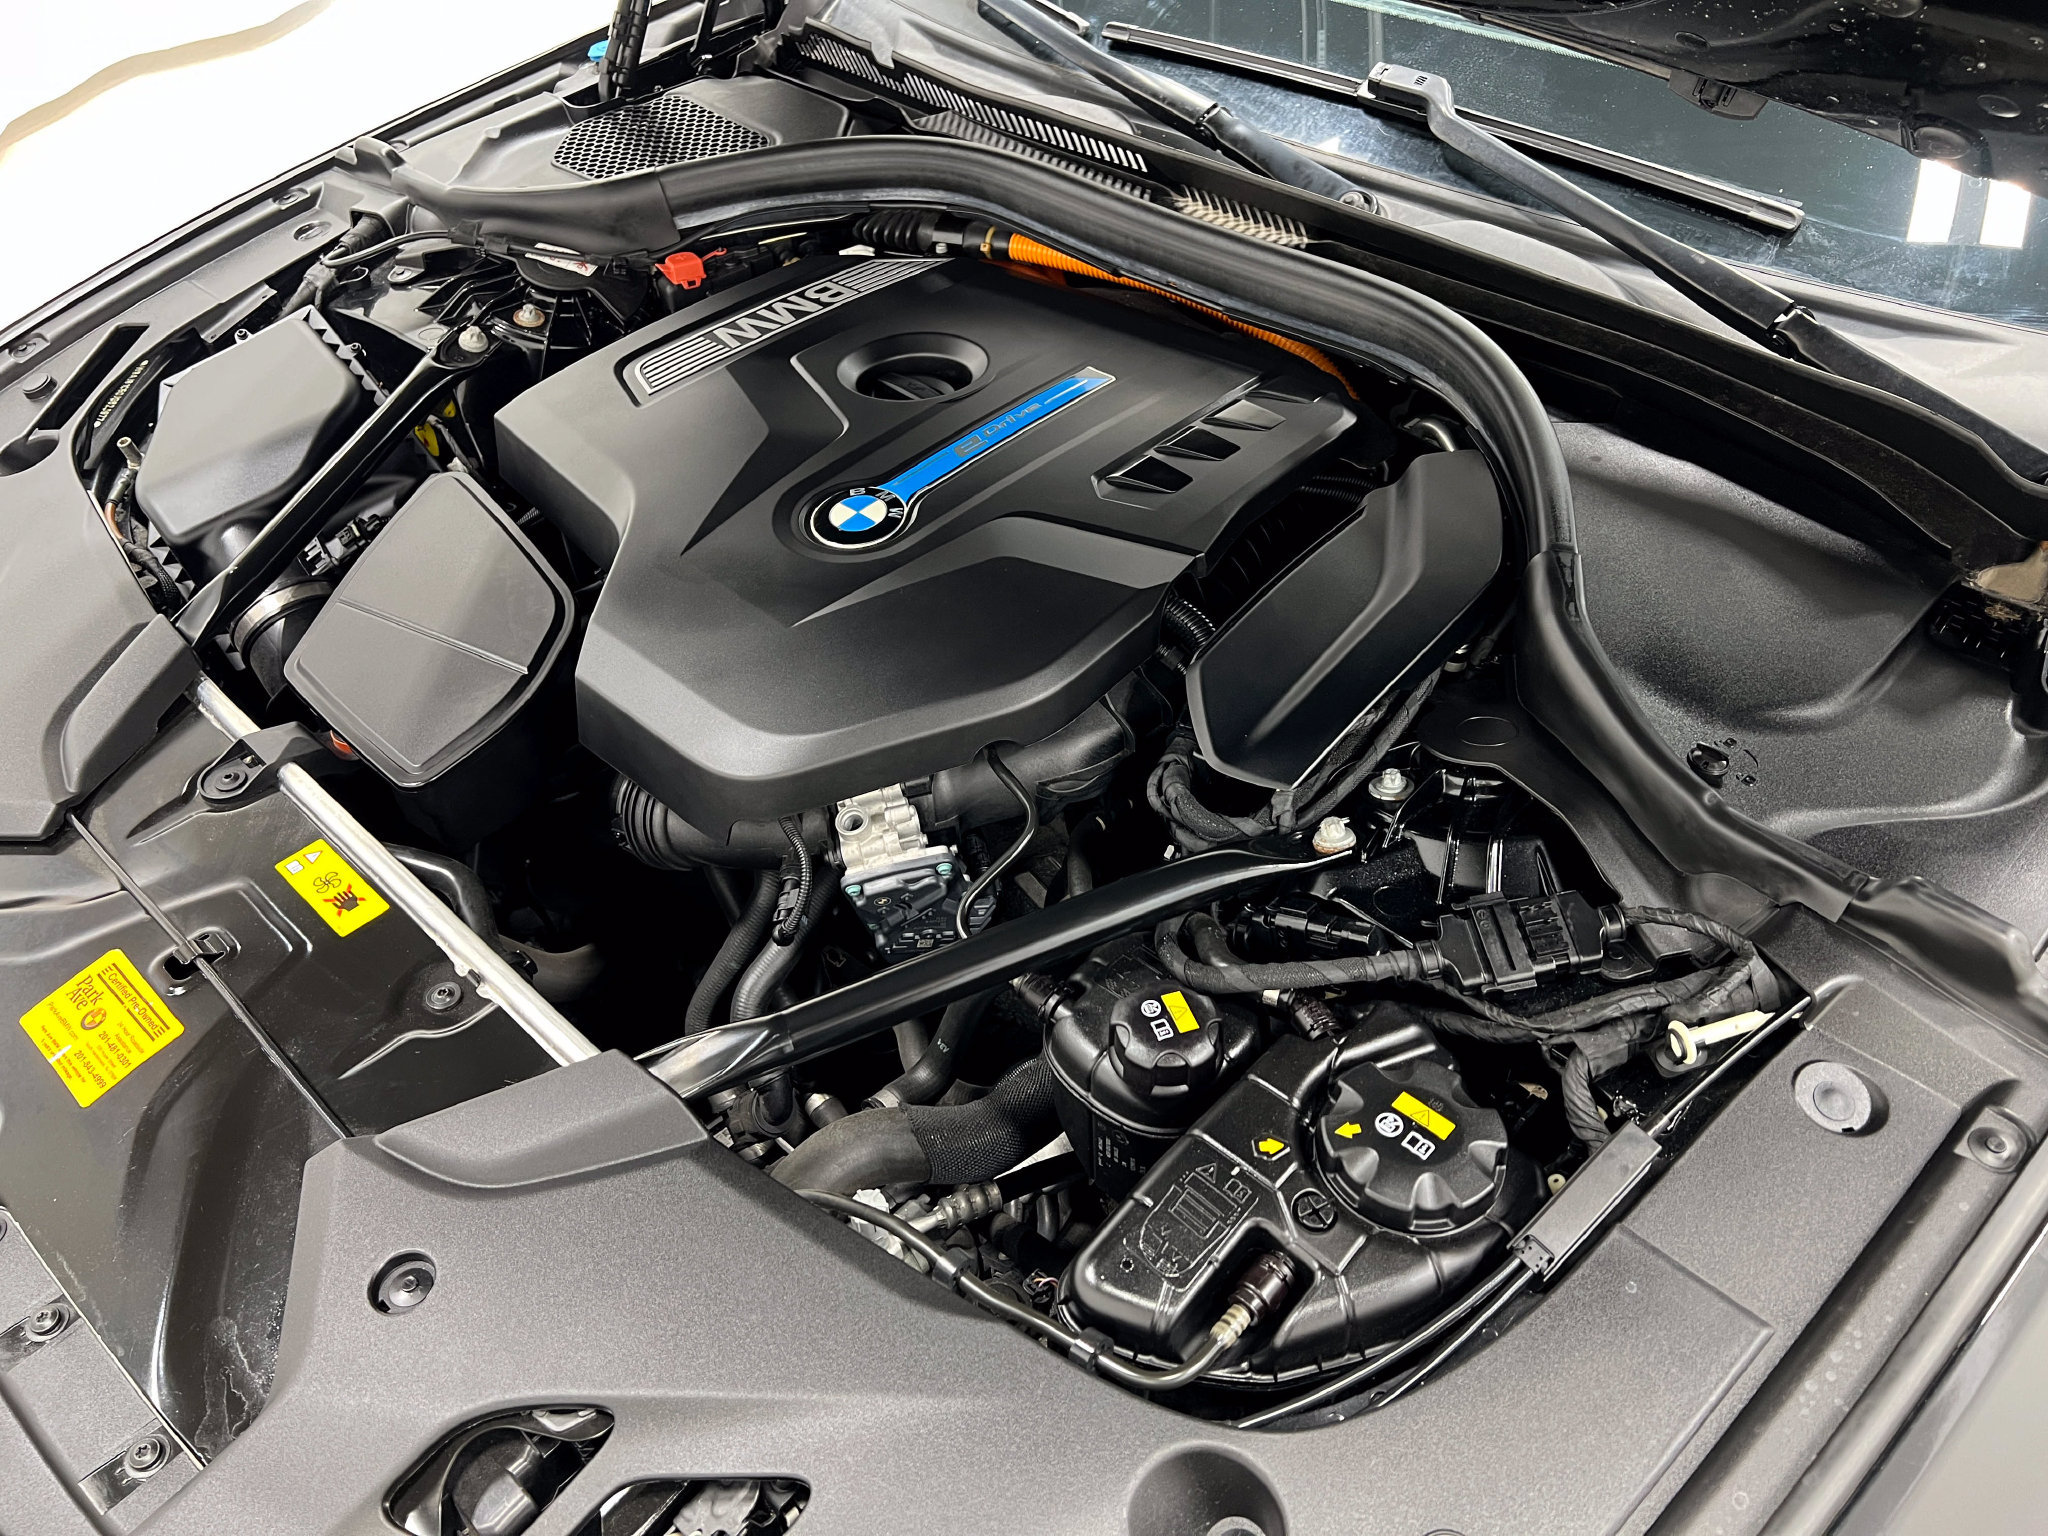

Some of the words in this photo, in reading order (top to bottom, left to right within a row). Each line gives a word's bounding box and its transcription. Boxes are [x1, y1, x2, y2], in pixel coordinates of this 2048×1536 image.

[711, 280, 859, 349] BMW
[849, 487, 904, 519] BMW
[66, 986, 89, 1011] Ave
[77, 974, 105, 1006] Park
[108, 972, 132, 1000] Certified
[128, 998, 159, 1031] Pre-Owned
[98, 1031, 132, 1068] 201-481-0301
[74, 1050, 107, 1089] 201-843-4999
